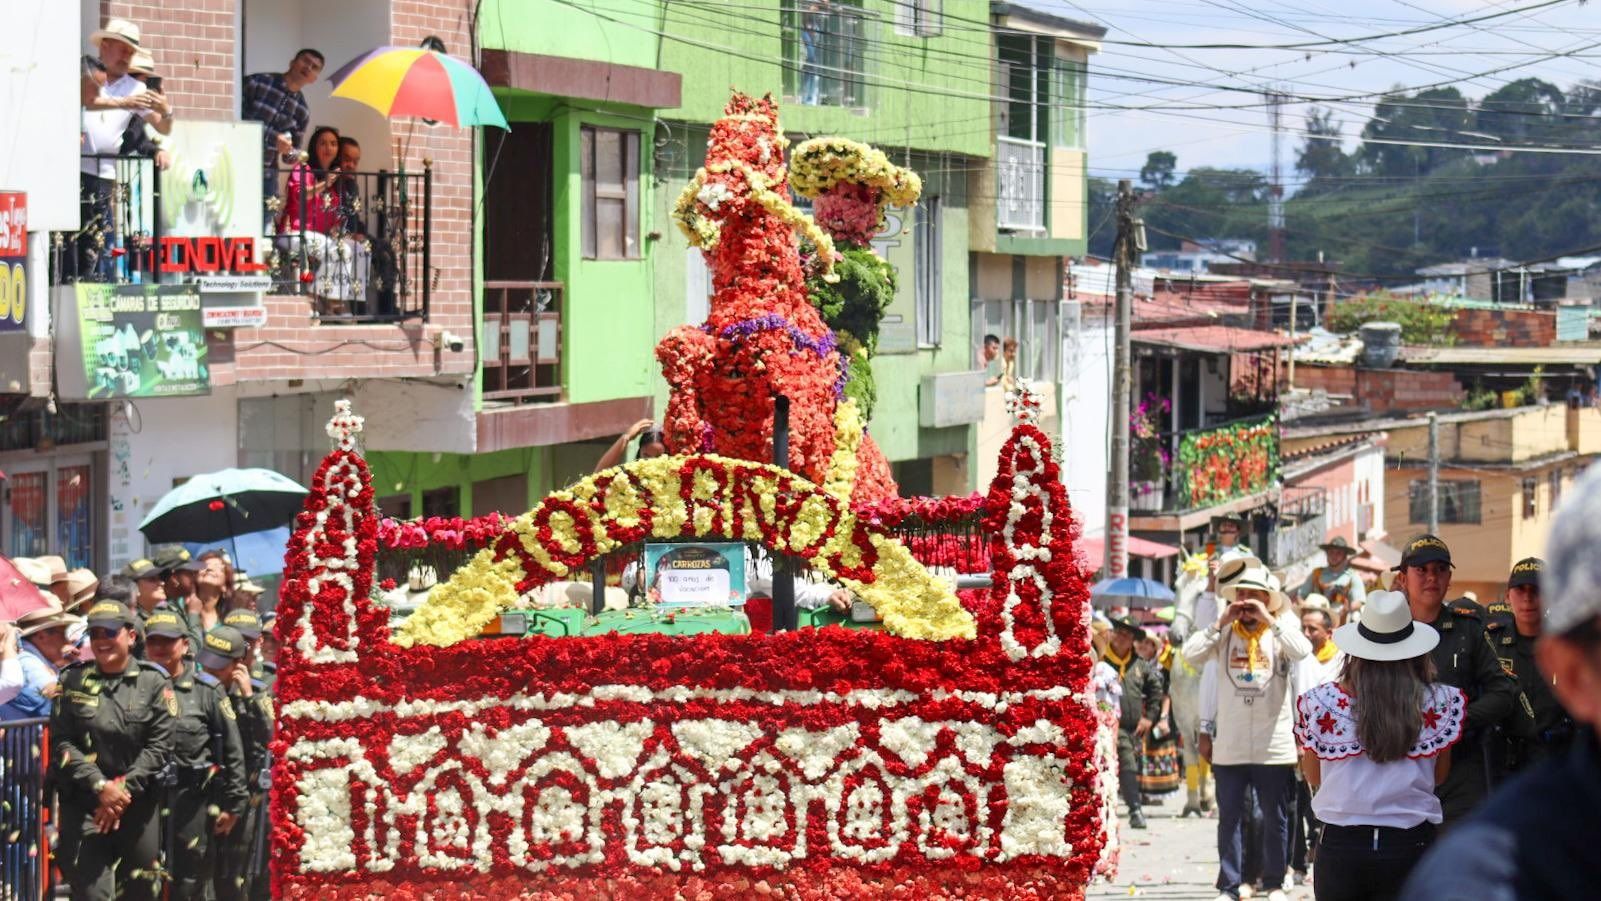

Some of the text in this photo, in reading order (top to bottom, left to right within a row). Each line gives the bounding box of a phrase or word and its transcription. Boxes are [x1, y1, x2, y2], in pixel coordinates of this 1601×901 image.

[203, 280, 269, 289] Technology Solutions
[147, 295, 158, 311] DE
[672, 560, 711, 570] CARROZAS
[205, 633, 232, 651] OLICIA
